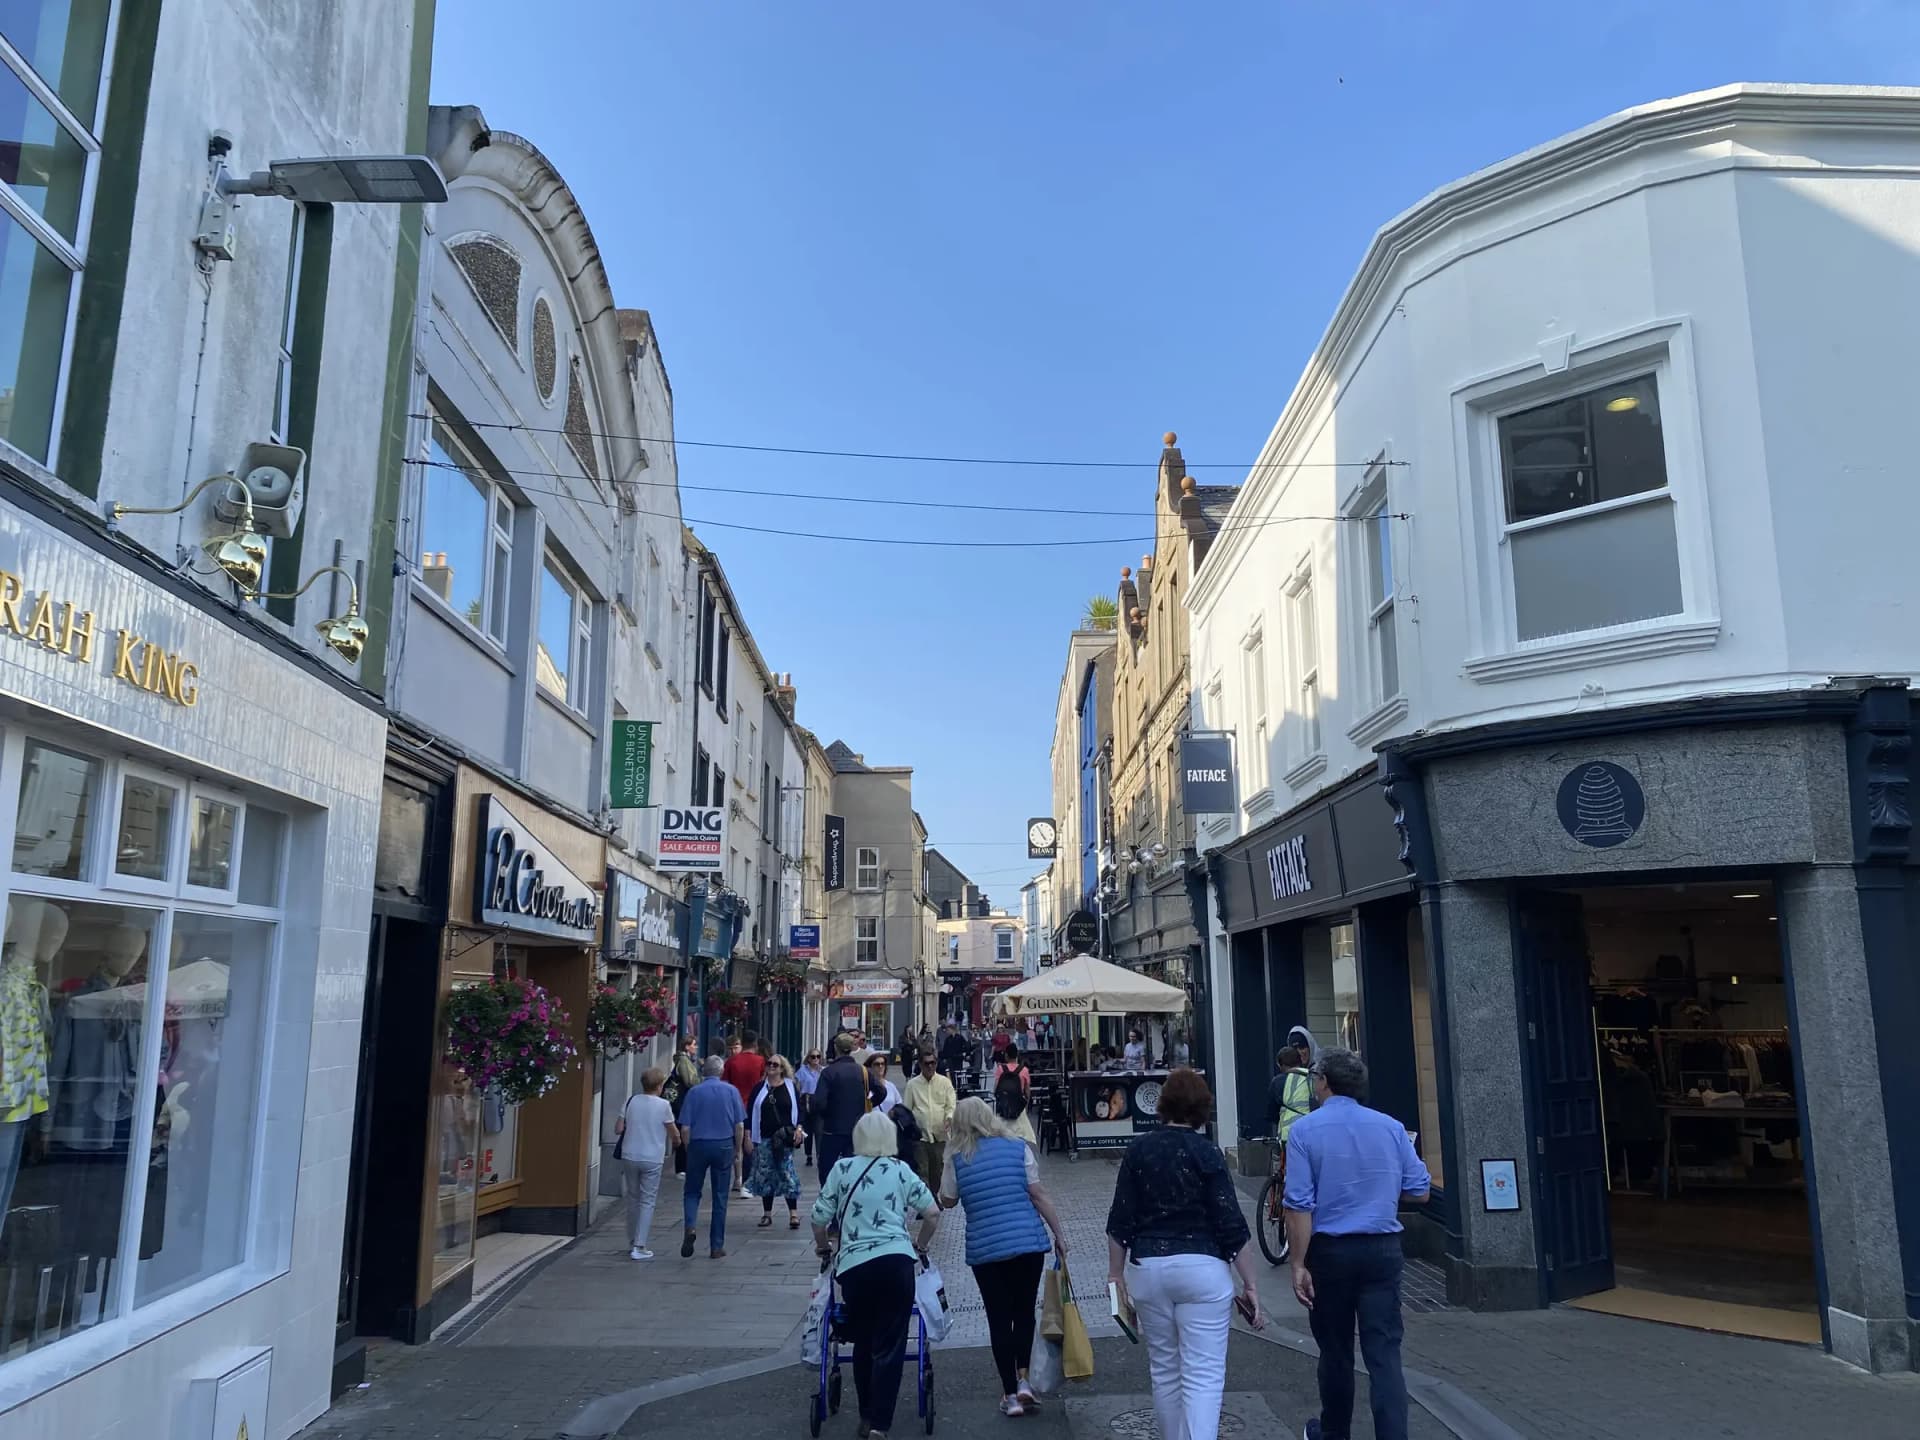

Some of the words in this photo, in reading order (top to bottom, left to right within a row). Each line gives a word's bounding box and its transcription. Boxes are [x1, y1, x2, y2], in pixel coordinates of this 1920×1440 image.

[113, 628, 199, 707] KING
[626, 724, 636, 739] OF
[637, 725, 648, 764] UNITED
[634, 766, 646, 805] COLORS
[1187, 769, 1227, 782] FATFACE
[663, 809, 722, 831] DNG
[663, 843, 684, 851] SALE
[685, 844, 718, 852] AGREED
[830, 839, 840, 887] Superdrug
[1266, 834, 1312, 901] FATFACE
[1026, 997, 1089, 1010] GUINNESS
